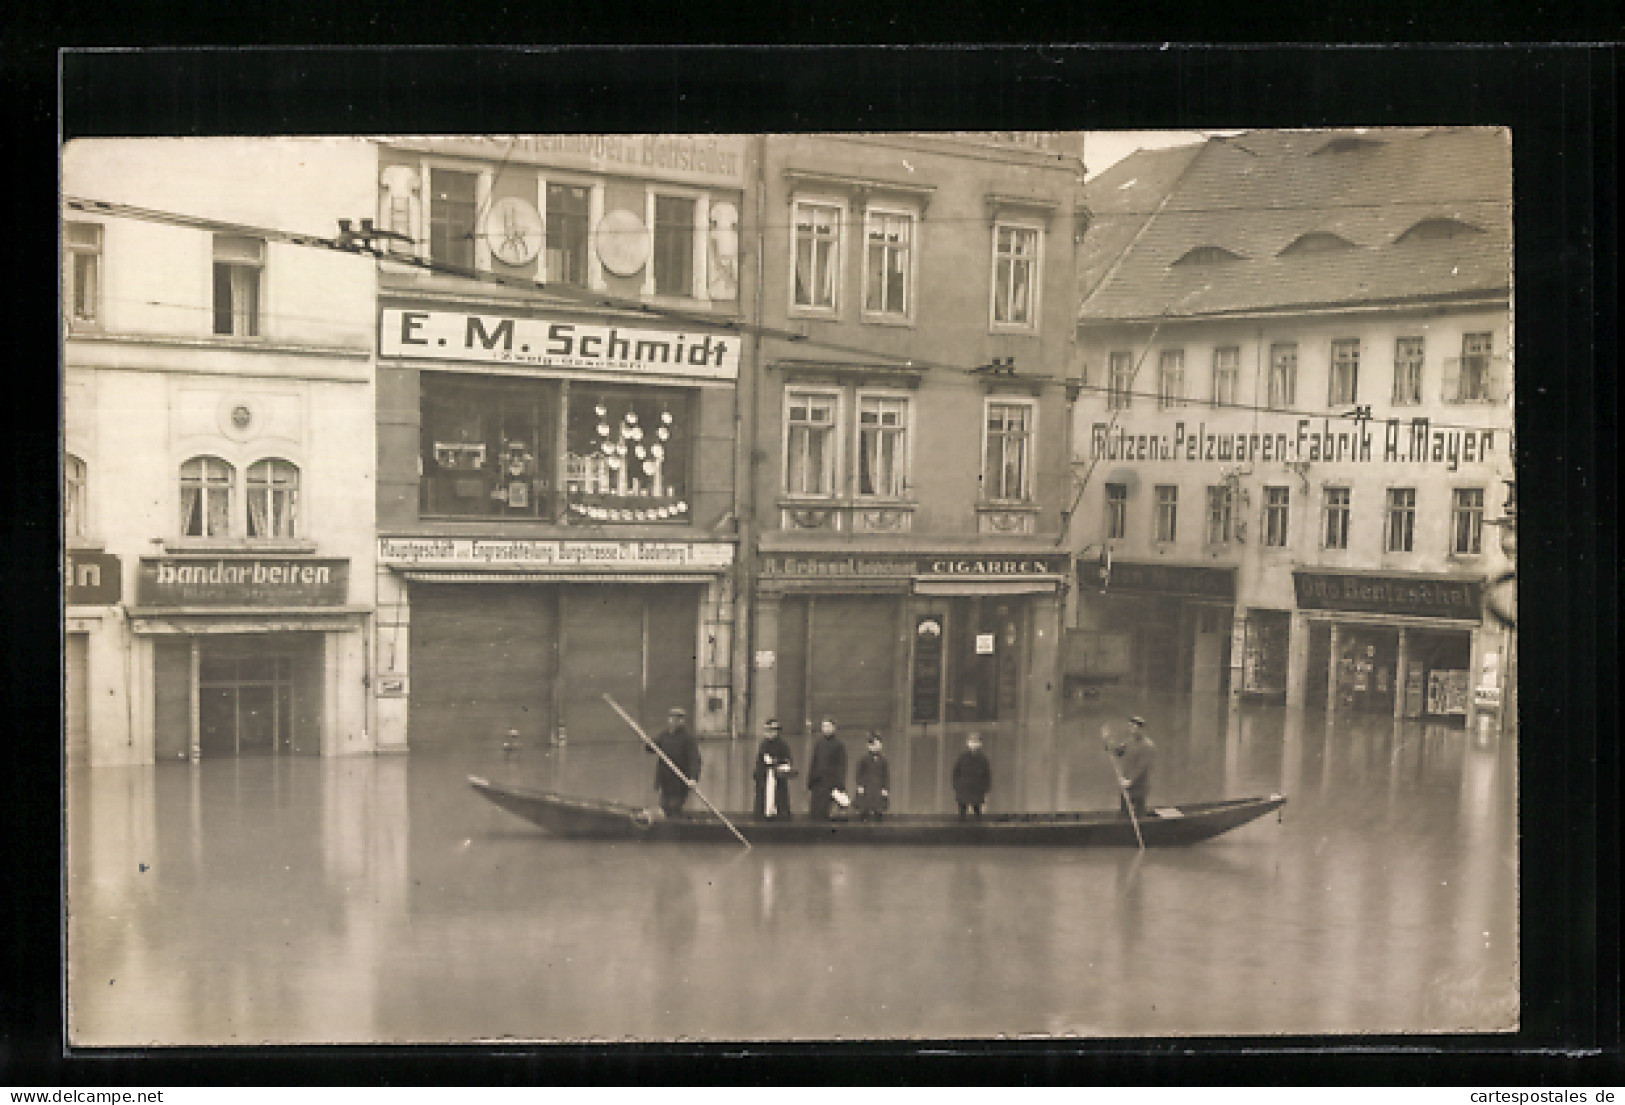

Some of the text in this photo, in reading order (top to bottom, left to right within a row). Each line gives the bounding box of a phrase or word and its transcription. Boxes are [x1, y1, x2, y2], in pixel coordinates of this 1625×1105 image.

[401, 311, 728, 367] E. M. Schmidt
[931, 560, 1049, 574] CIGARREN
